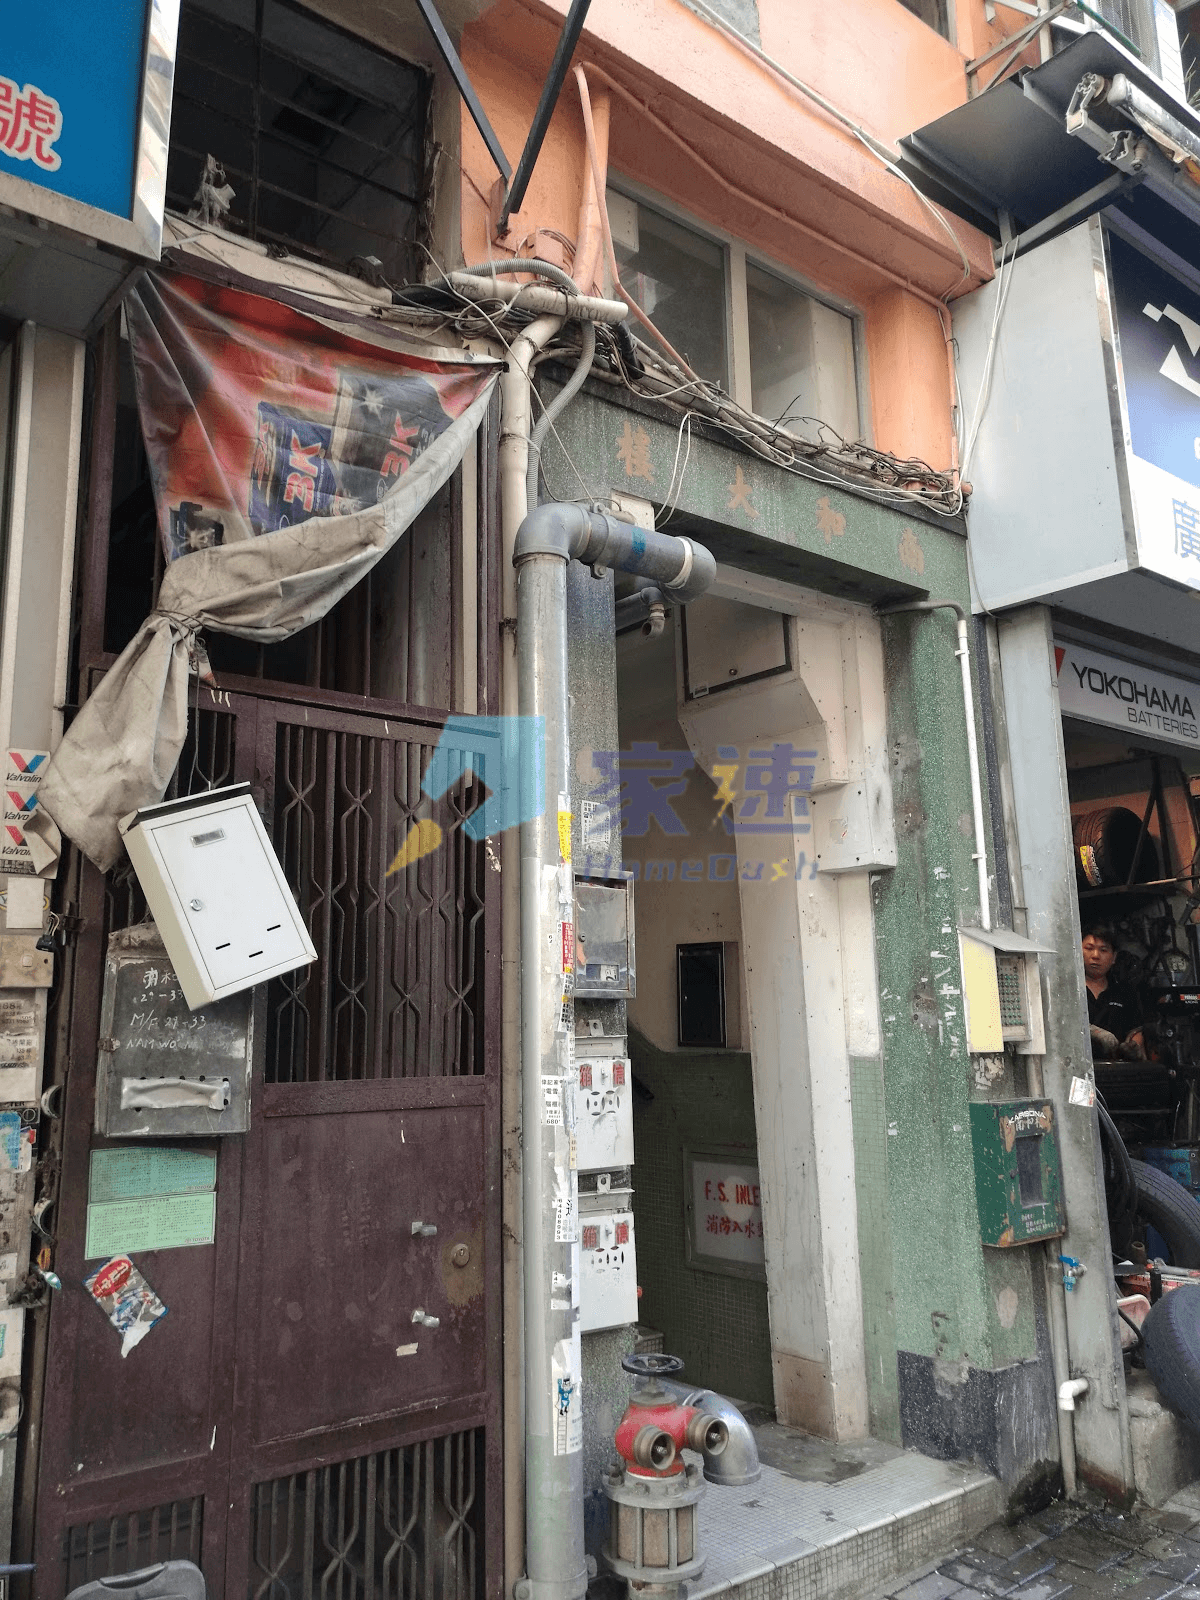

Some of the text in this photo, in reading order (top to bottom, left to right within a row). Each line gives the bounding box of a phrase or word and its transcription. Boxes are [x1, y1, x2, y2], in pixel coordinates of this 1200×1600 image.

[283, 428, 323, 513] 3K
[1070, 661, 1196, 720] YOKOHAMA
[1127, 706, 1199, 739] BATTERIES
